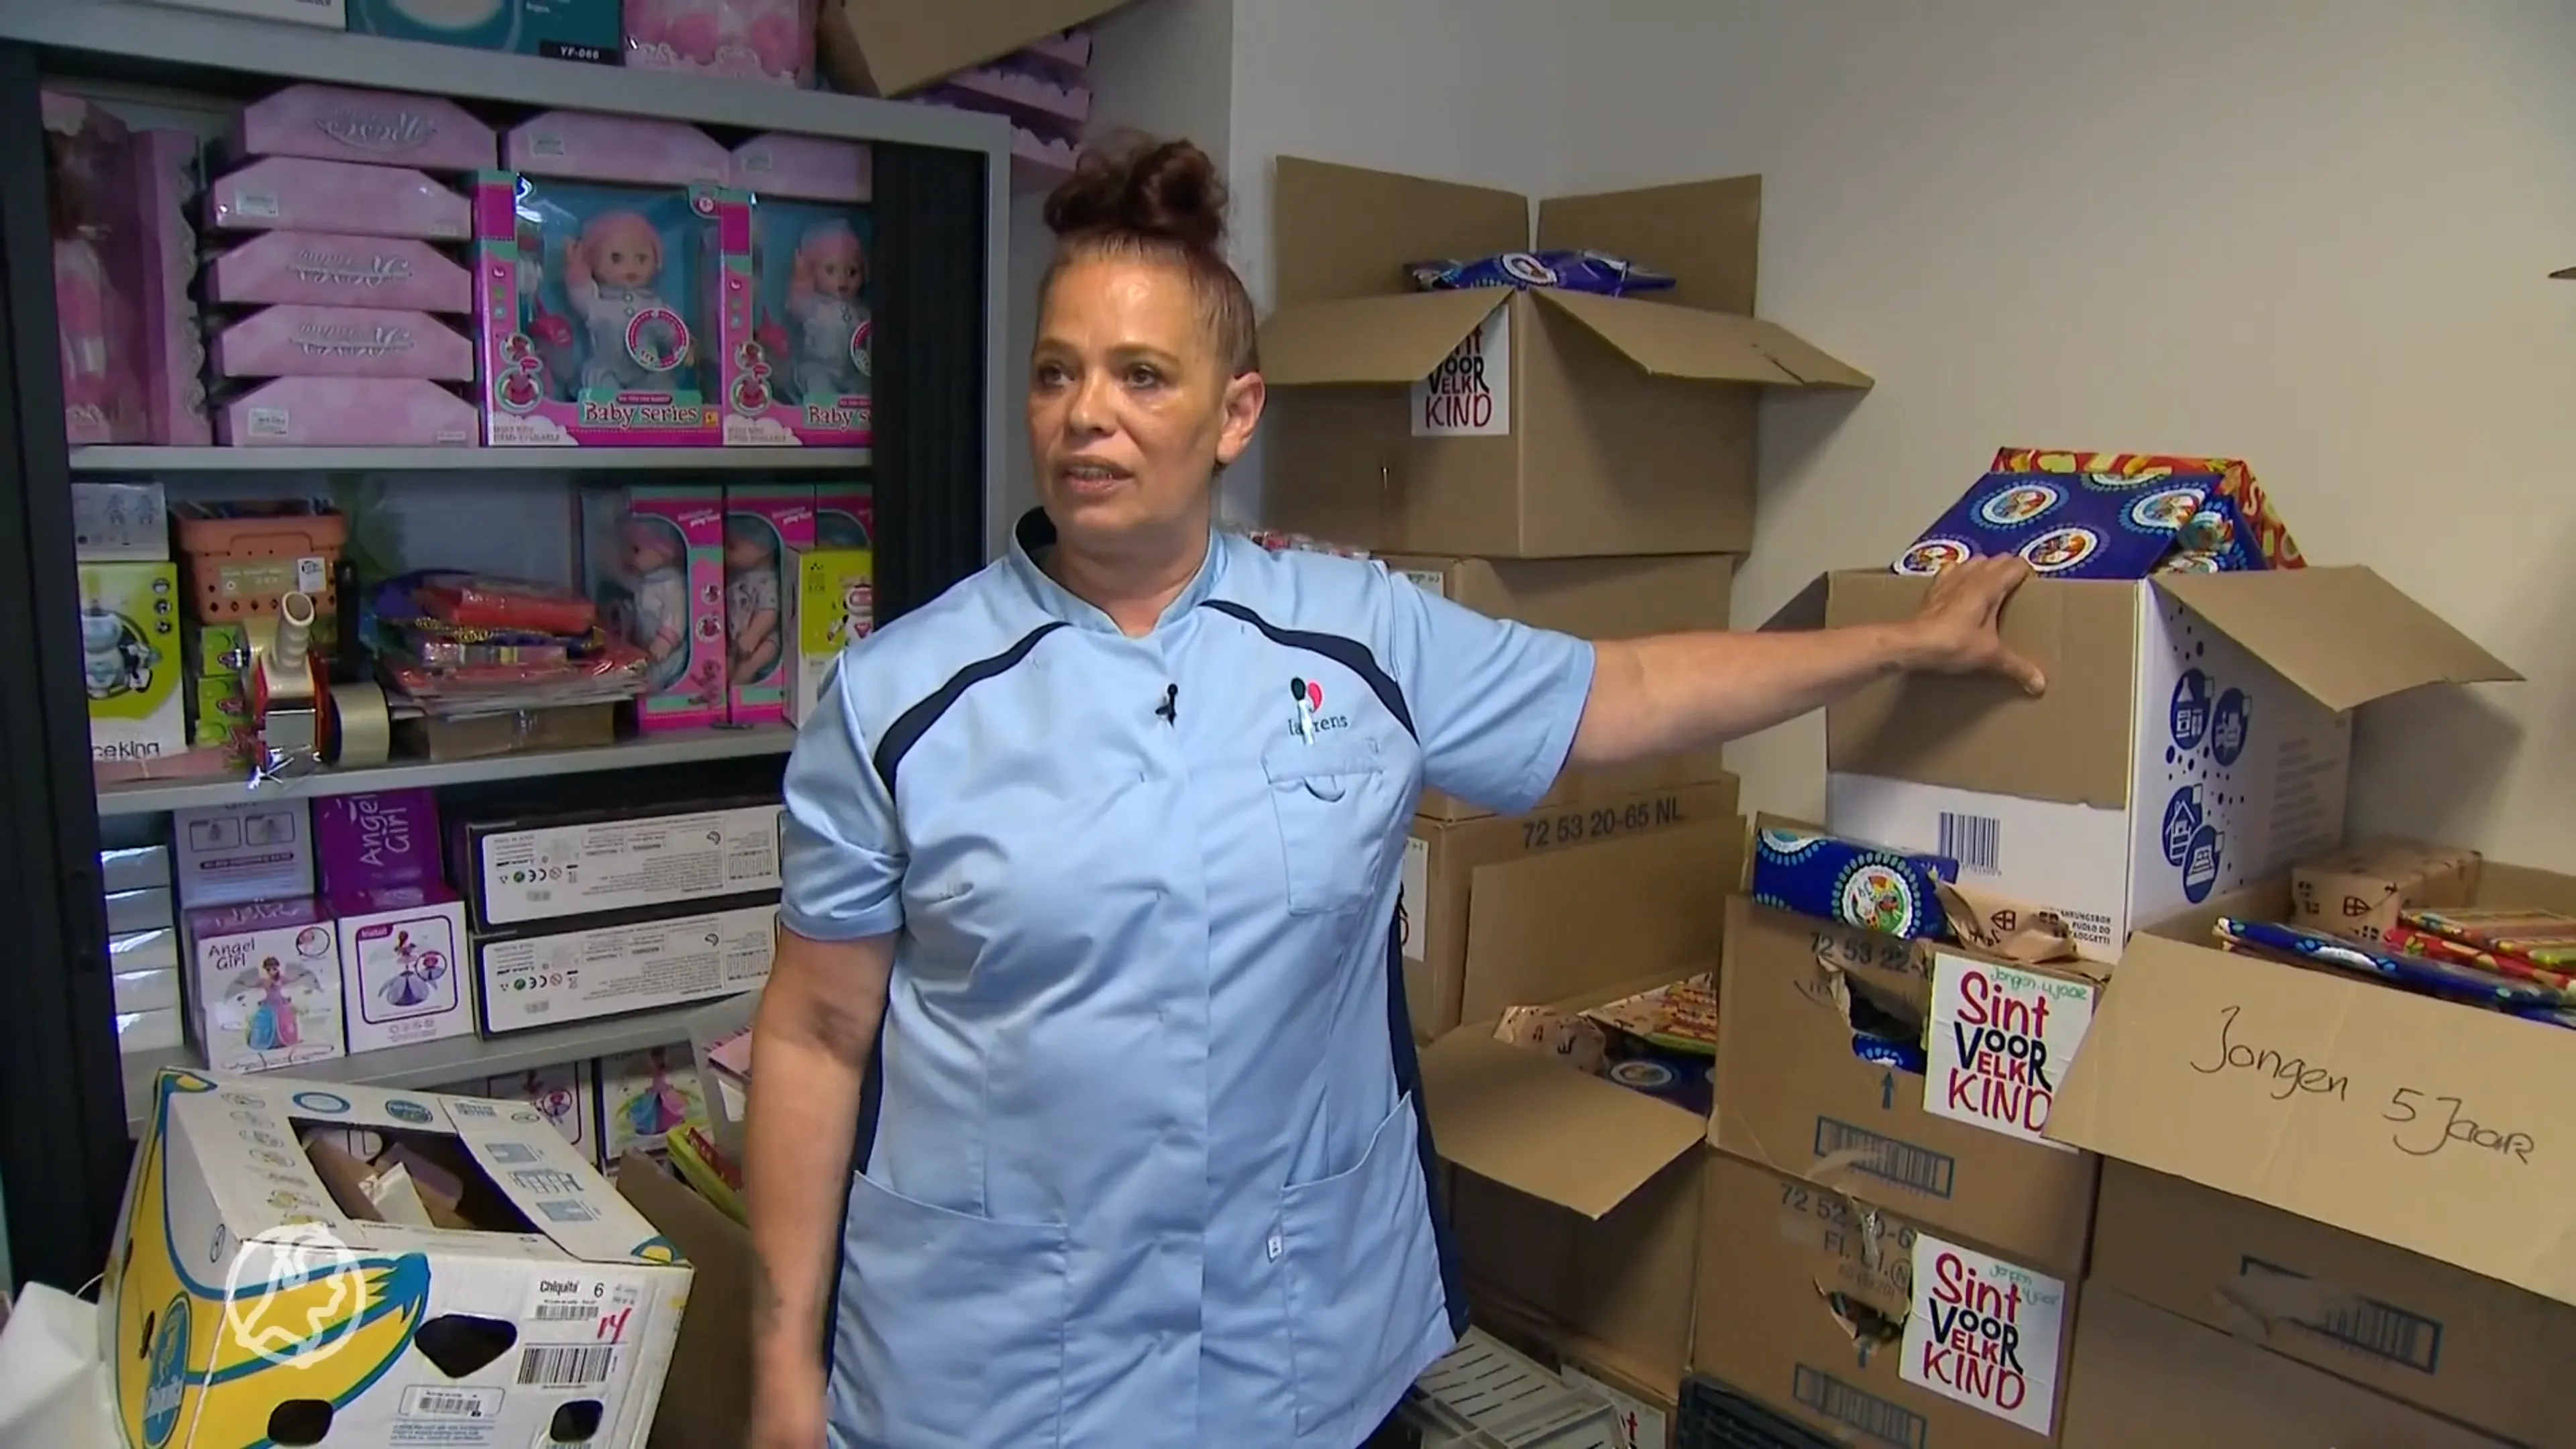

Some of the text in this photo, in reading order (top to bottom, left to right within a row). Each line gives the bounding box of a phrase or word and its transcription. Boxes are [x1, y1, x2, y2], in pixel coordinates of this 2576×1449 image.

[1428, 356, 1490, 394] VOOR
[1442, 375, 1472, 394] ELK
[585, 402, 698, 428] Baby series
[809, 405, 853, 429] Baby
[1426, 393, 1492, 429] KIND
[1288, 715, 1348, 736] larens
[351, 794, 388, 867] Angel
[380, 807, 410, 853] Girl
[1522, 818, 1550, 849] 72
[1557, 814, 1583, 843] 53
[1656, 796, 1684, 826] NL
[208, 936, 255, 958] Angel
[216, 953, 246, 971] Girl
[1957, 971, 2049, 1039] Sint
[1953, 1020, 2053, 1093] VOOR
[1977, 1050, 2026, 1085] ELK
[2190, 1005, 2349, 1101] Jongen
[2382, 1087, 2424, 1122] 5
[1948, 1067, 2053, 1132] KIND
[594, 1282, 605, 1299] 6
[1932, 1252, 2022, 1324] Sint
[1928, 1297, 2024, 1376] VOOR
[1951, 1328, 1999, 1365] ELK
[1923, 1340, 2026, 1411] KIND
